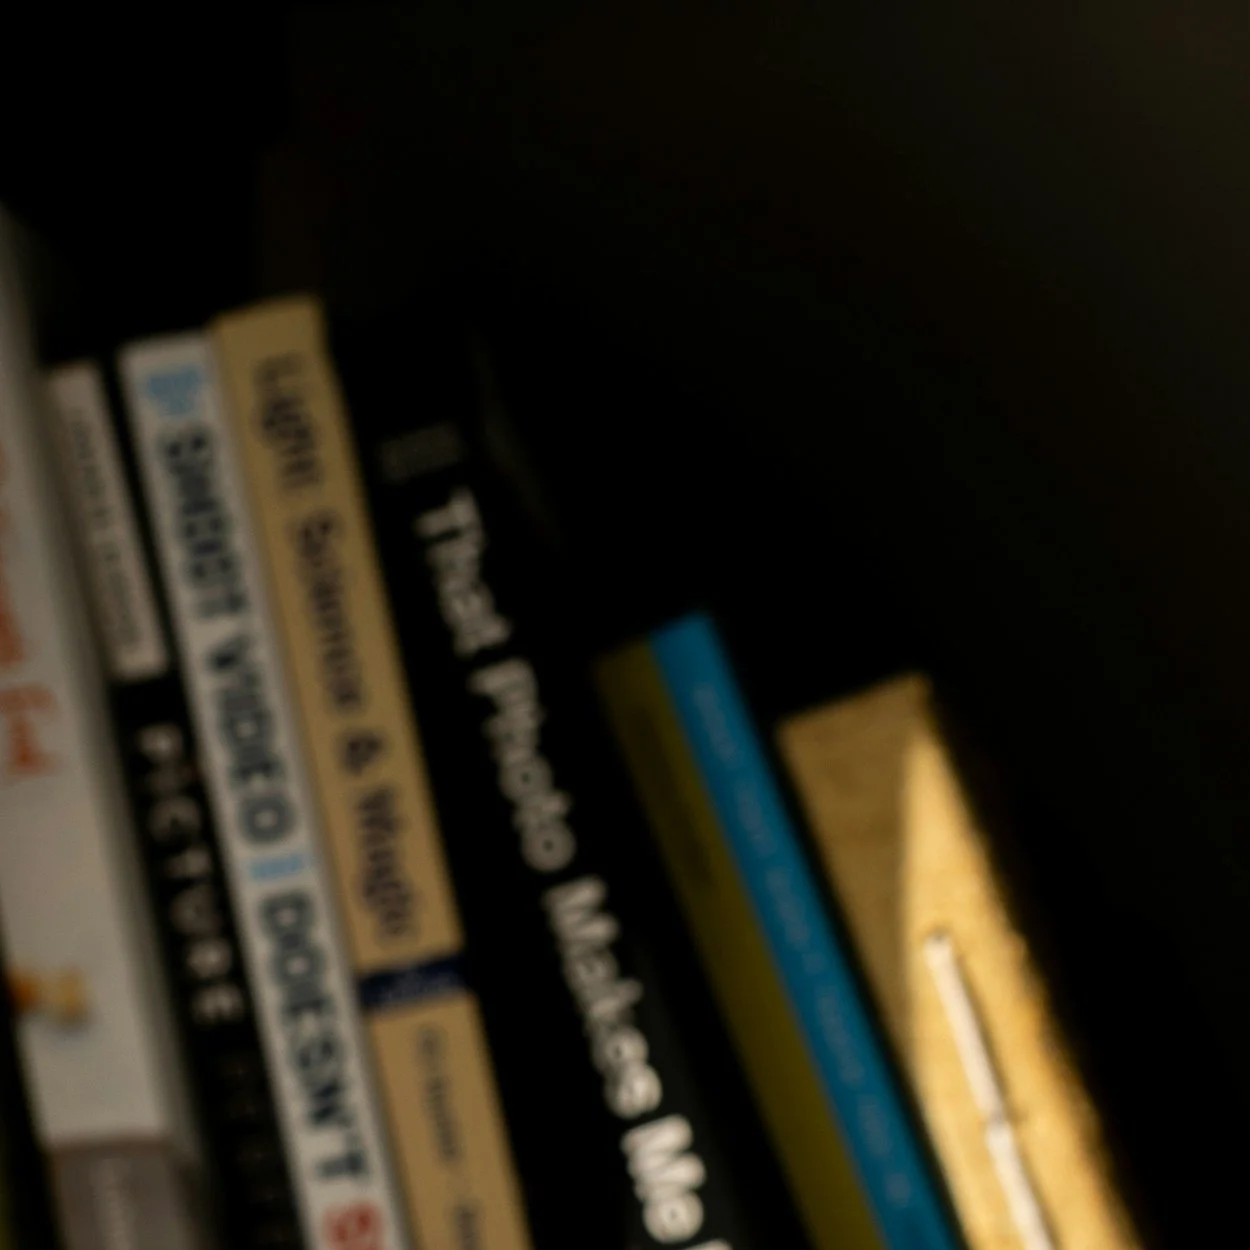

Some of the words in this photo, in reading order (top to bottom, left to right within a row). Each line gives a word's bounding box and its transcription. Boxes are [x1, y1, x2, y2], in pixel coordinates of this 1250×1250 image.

[159, 426, 247, 622] SHOOT
[205, 632, 300, 845] VIDEO
[255, 888, 368, 1182] DOESN'T
[408, 483, 514, 660] That
[463, 651, 579, 874] Photo
[538, 870, 664, 1120] Makes
[620, 1113, 707, 1245] Me
